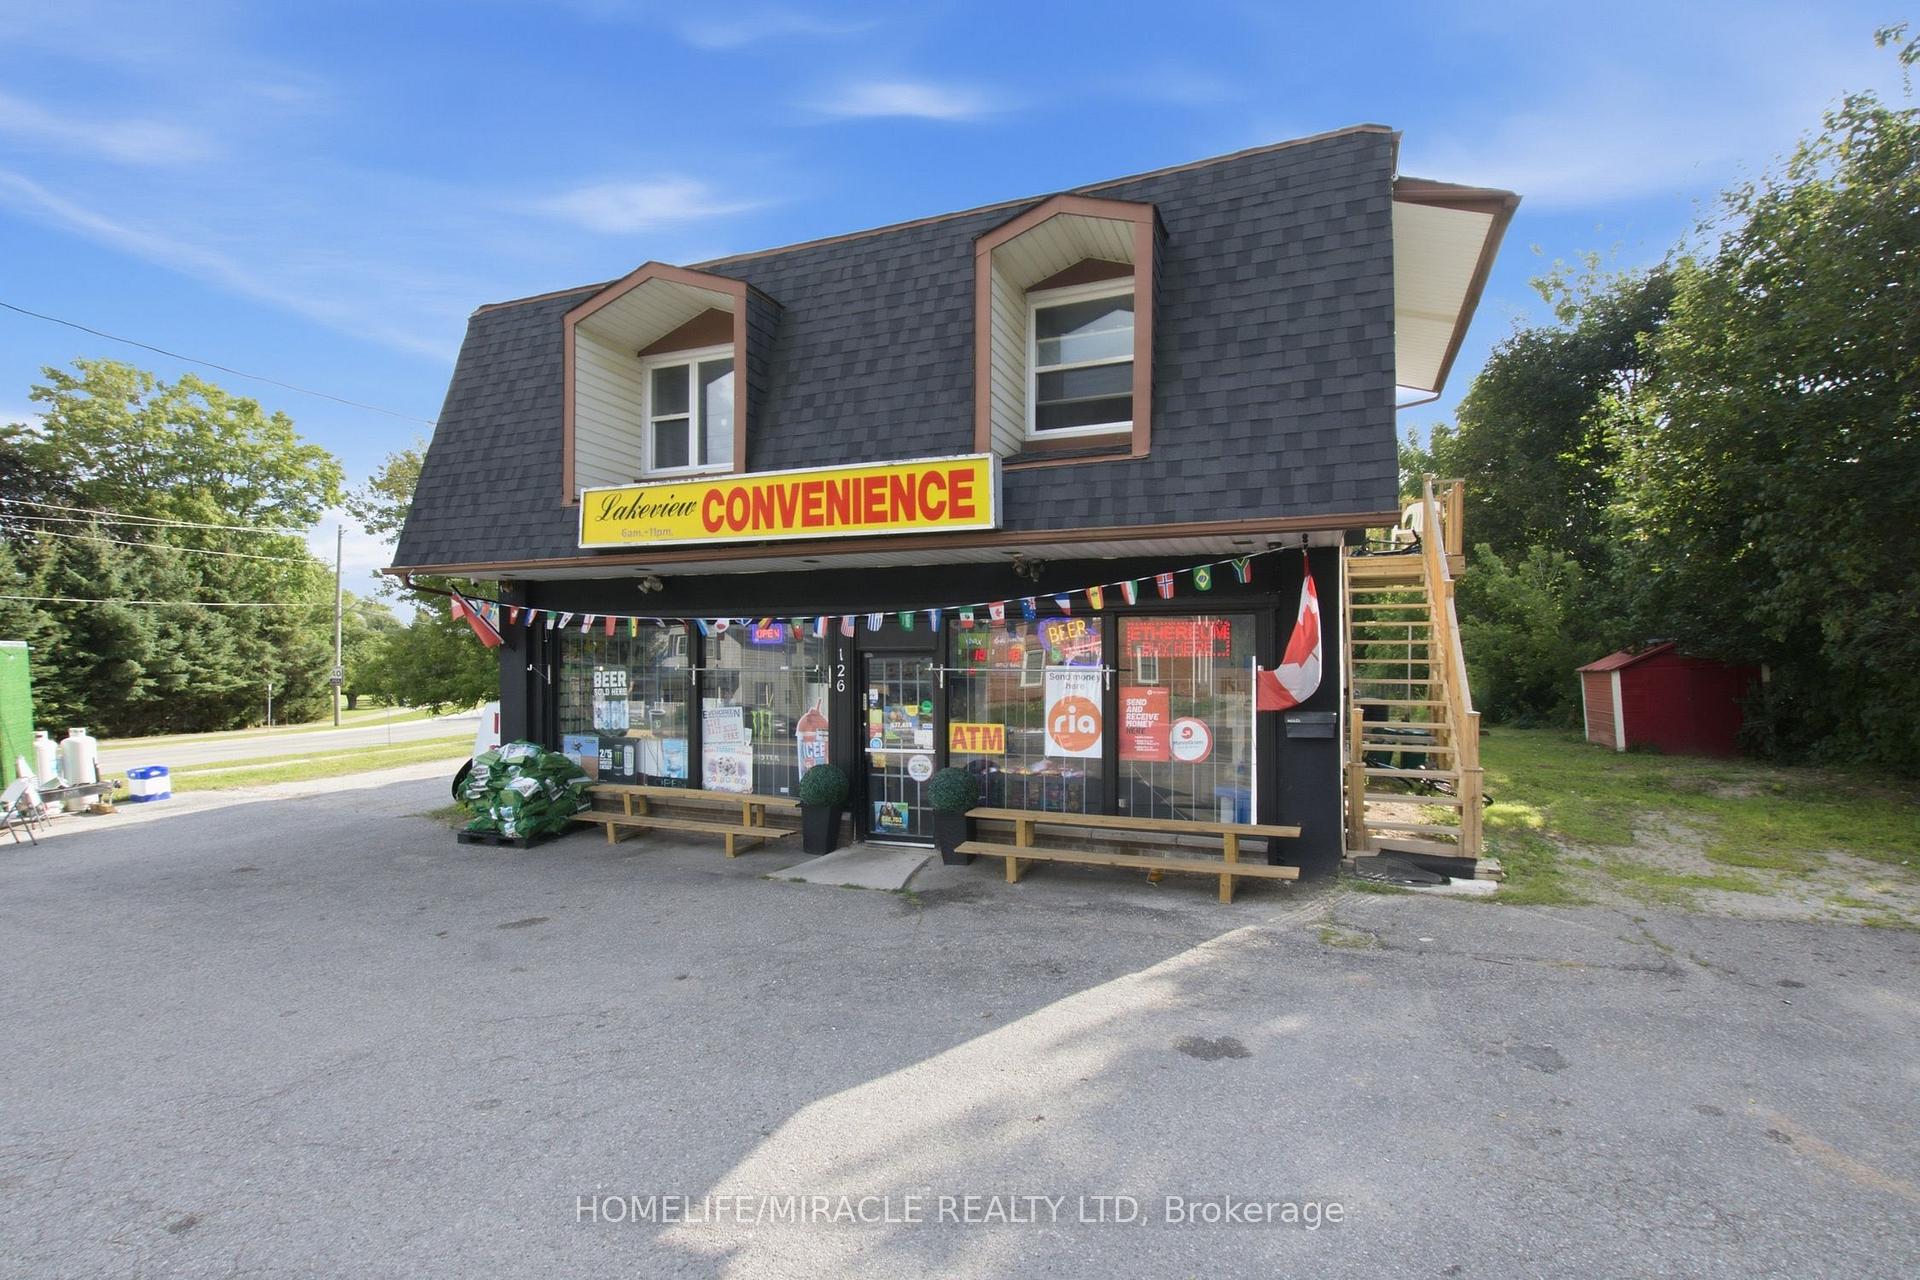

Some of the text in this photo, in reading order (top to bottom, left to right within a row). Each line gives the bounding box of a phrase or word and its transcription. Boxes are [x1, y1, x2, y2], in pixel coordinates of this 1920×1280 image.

[595, 468, 976, 533] Lakeview CONVENIENCE
[756, 628, 780, 639] OPEN
[1048, 620, 1088, 643] BEER
[593, 671, 627, 687] BEER
[1049, 673, 1101, 682] Send money
[594, 688, 610, 696] SOLD
[1126, 698, 1148, 706] SEND
[1054, 705, 1096, 734] ria
[1126, 713, 1160, 721] RECEIVE
[1125, 720, 1154, 728] MONEY
[951, 726, 1004, 750] ATM
[804, 742, 826, 758] ICEE
